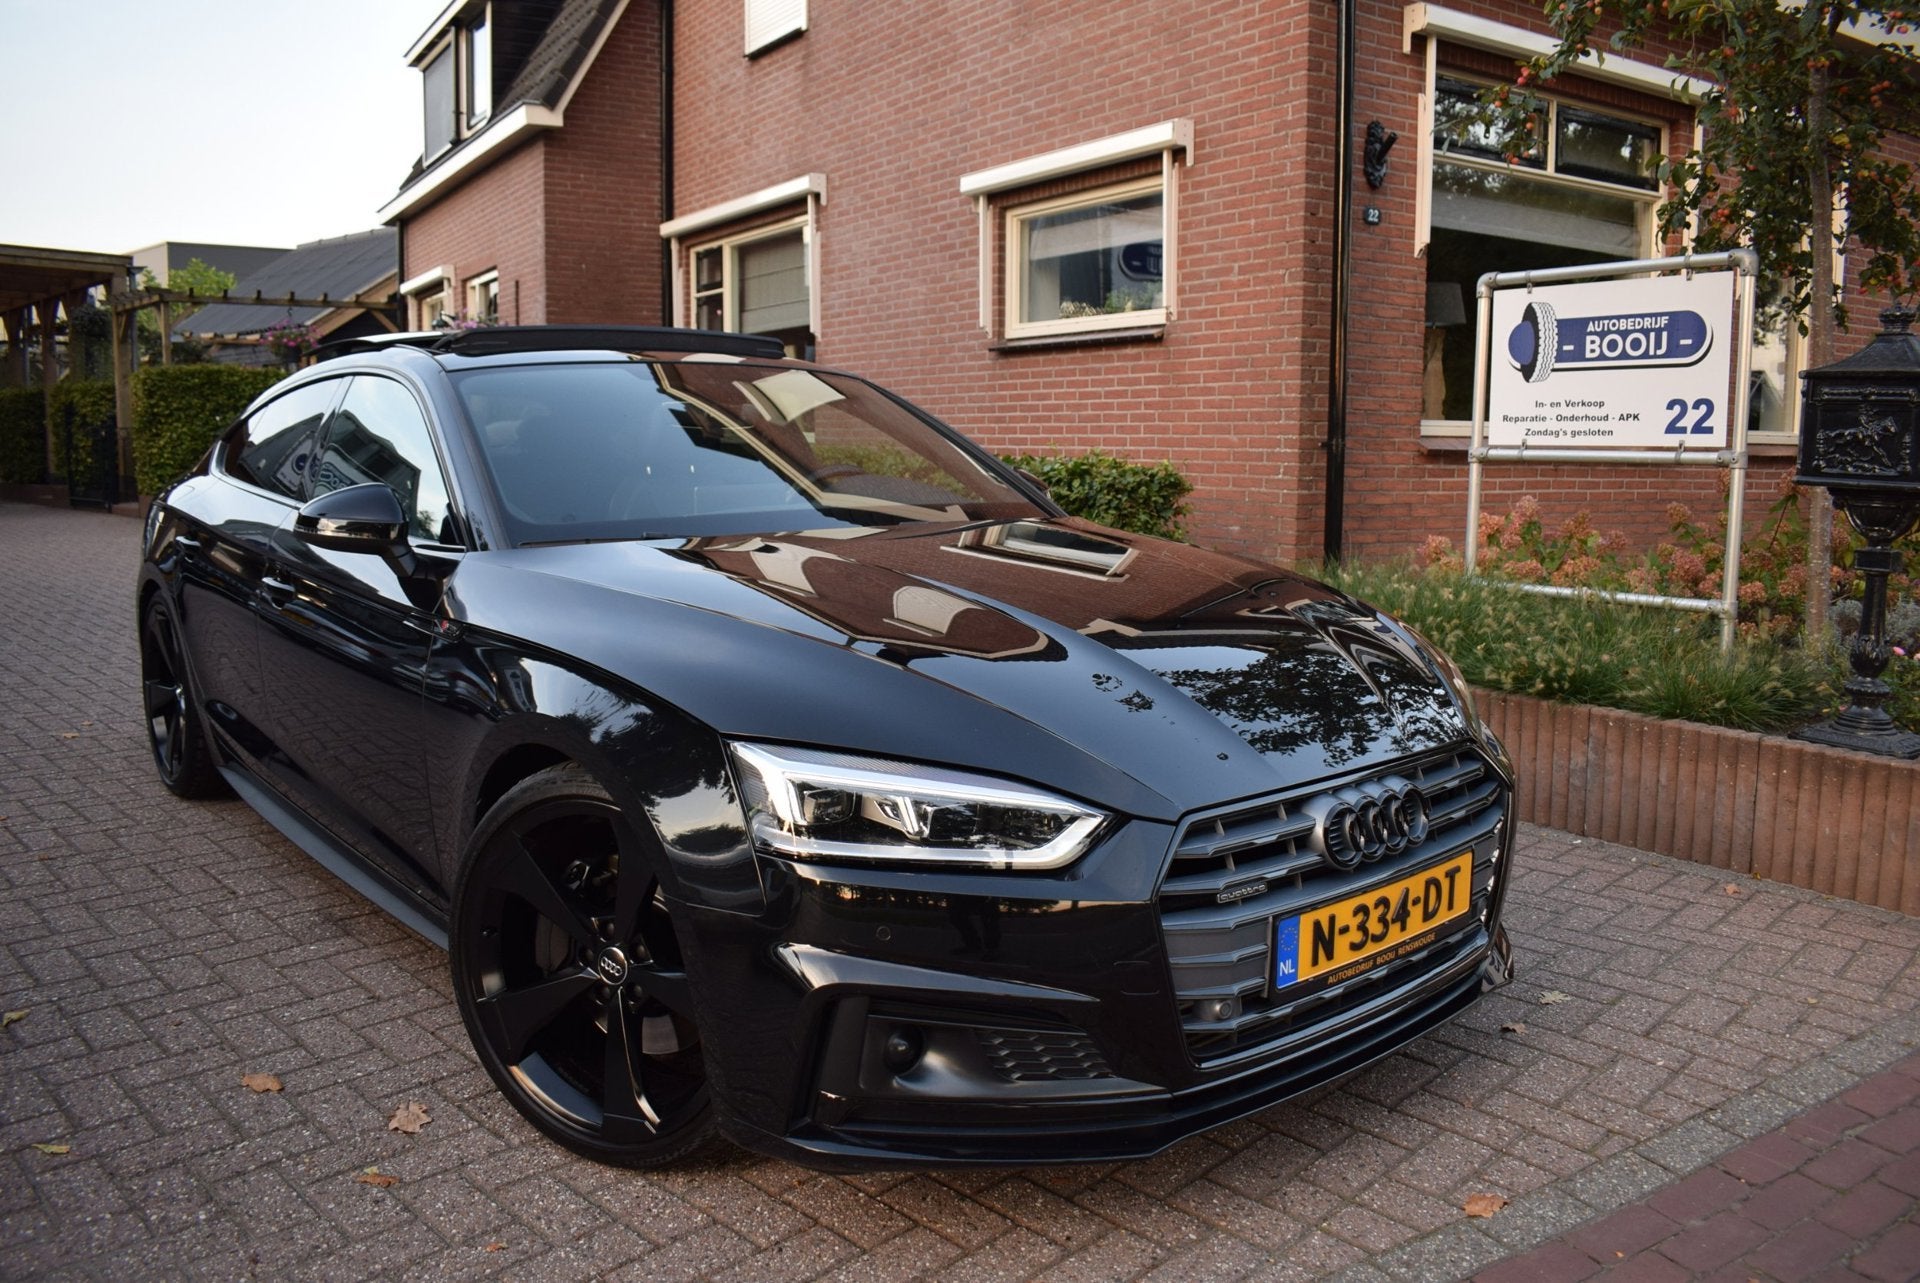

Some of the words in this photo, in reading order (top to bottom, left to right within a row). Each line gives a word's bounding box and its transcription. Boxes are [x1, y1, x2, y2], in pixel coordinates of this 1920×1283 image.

[1368, 208, 1379, 222] 22
[1586, 316, 1670, 333] AUTOBEDRIJF
[1585, 331, 1669, 359] BOOIJ
[1535, 400, 1548, 408] In-
[1564, 400, 1605, 409] Verkoop
[1502, 414, 1548, 424] Reparatie
[1555, 413, 1609, 422] Onderhoud
[1618, 413, 1640, 421] APK
[1664, 398, 1715, 435] 22
[1525, 428, 1568, 438] Zondag's
[1570, 428, 1614, 438] gesloten
[1219, 884, 1266, 901] quattro
[1311, 865, 1461, 967] N-334-DT
[1279, 958, 1296, 976] NL
[1327, 959, 1374, 985] AUTOBEDRIJF
[1398, 932, 1436, 956] RENSWOUDE
